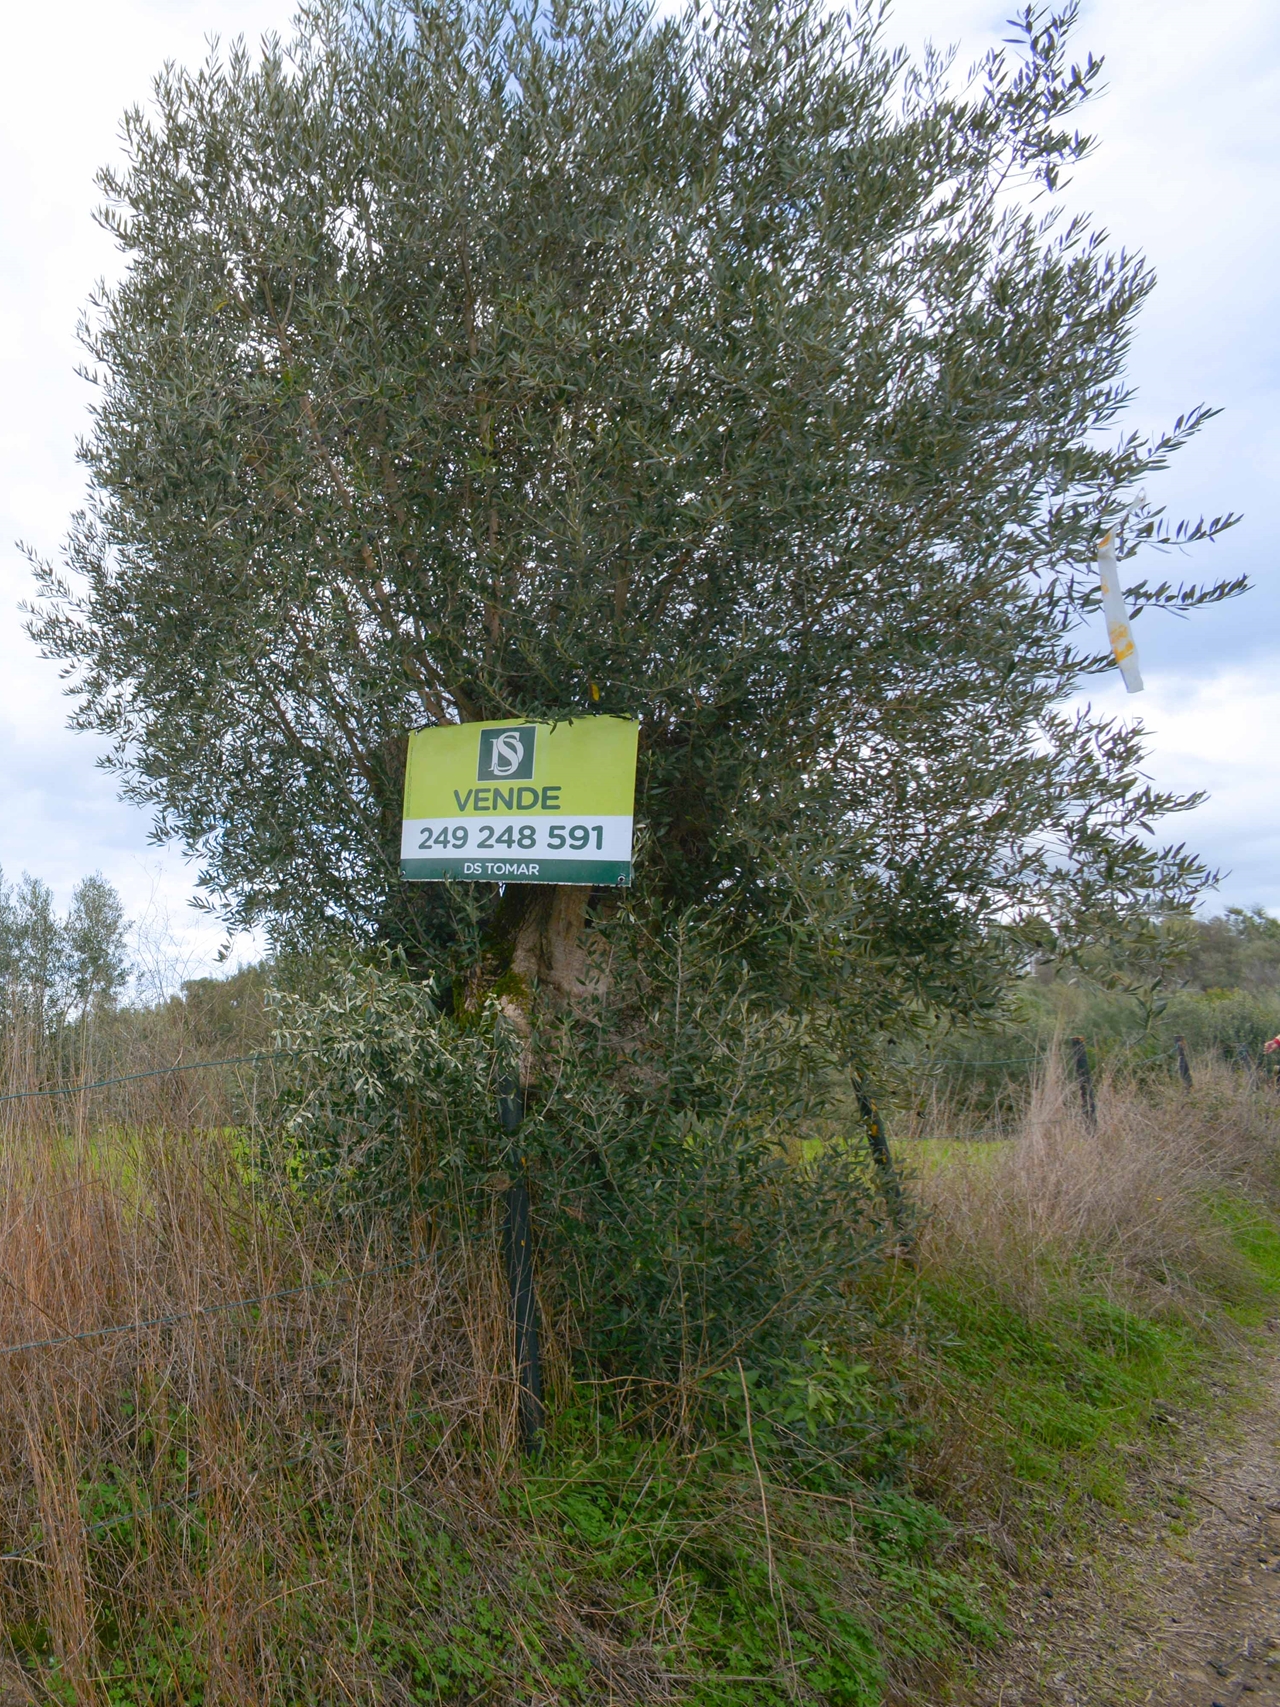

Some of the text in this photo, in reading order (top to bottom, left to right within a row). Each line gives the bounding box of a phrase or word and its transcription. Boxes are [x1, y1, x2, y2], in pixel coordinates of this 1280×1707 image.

[454, 786, 562, 812] VENDE
[418, 825, 604, 851] 249 248 591
[464, 862, 539, 875] DS TOMAR
